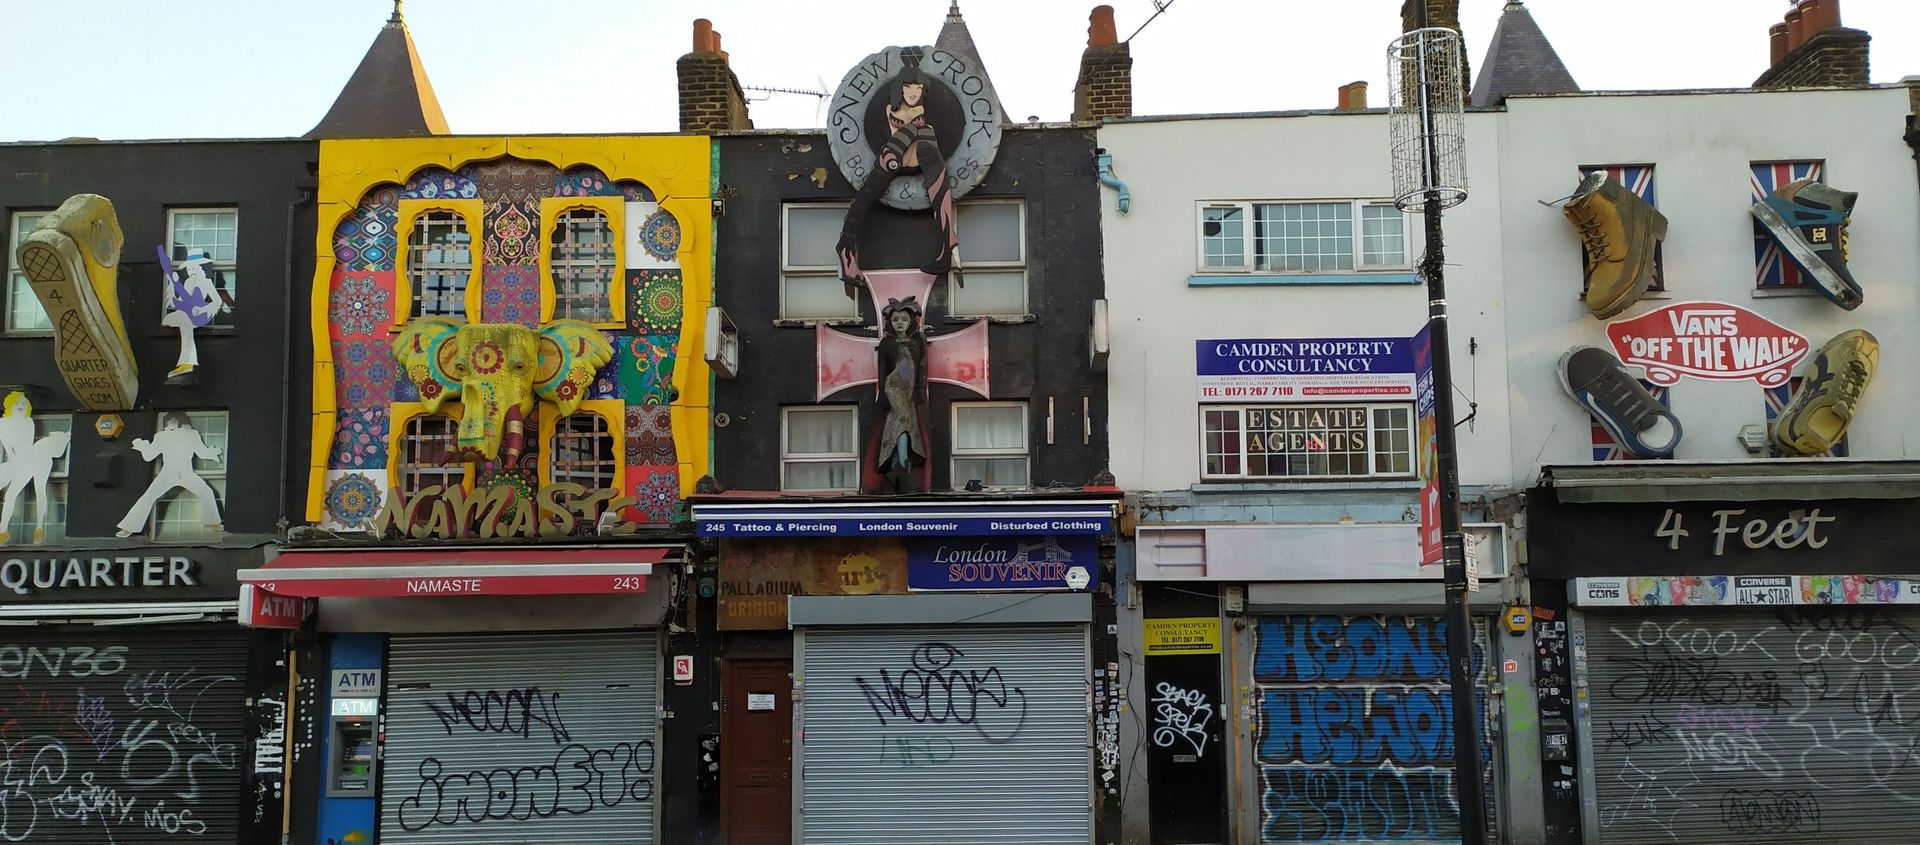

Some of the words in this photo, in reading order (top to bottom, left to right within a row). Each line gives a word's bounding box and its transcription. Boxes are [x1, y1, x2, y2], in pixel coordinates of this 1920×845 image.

[832, 51, 890, 145] NEW
[931, 50, 993, 147] ROCK
[899, 182, 914, 200] &
[49, 289, 63, 304] 4
[1216, 342, 1294, 357] CAMDEN
[1298, 341, 1395, 356] PROPERTY
[1677, 336, 1727, 371] THE
[60, 359, 109, 373] QUARTER
[1238, 358, 1373, 373] CONSULTANCY
[73, 377, 111, 389] SHOES
[1203, 387, 1222, 396] TEL:
[1225, 387, 1247, 396] 0171
[1249, 387, 1268, 396] 267
[1272, 386, 1293, 396] 7110
[1248, 409, 1365, 428] ESTATE
[1249, 431, 1365, 451] AGENTS
[705, 523, 725, 532] 245
[733, 523, 771, 532] Tattoo
[775, 523, 784, 532] &
[788, 523, 837, 533] Piercing
[859, 523, 902, 531] London
[906, 522, 958, 531] Souvenir
[990, 521, 1048, 530] Disturbed
[1051, 521, 1102, 531] Clothing
[1654, 508, 1690, 550] 4
[1711, 507, 1837, 556] Feet
[933, 542, 1008, 563] London
[1, 557, 196, 594] QUARTER
[949, 561, 1068, 582] SOUVENIR
[406, 579, 482, 594] NAMASTE
[613, 577, 640, 591] 243
[1740, 578, 1787, 586] CONVERSE
[1739, 588, 1753, 604] ALL
[1768, 588, 1791, 604] STAR
[260, 596, 296, 618] ATM
[338, 672, 376, 687] ATM
[338, 701, 372, 713] ATM
